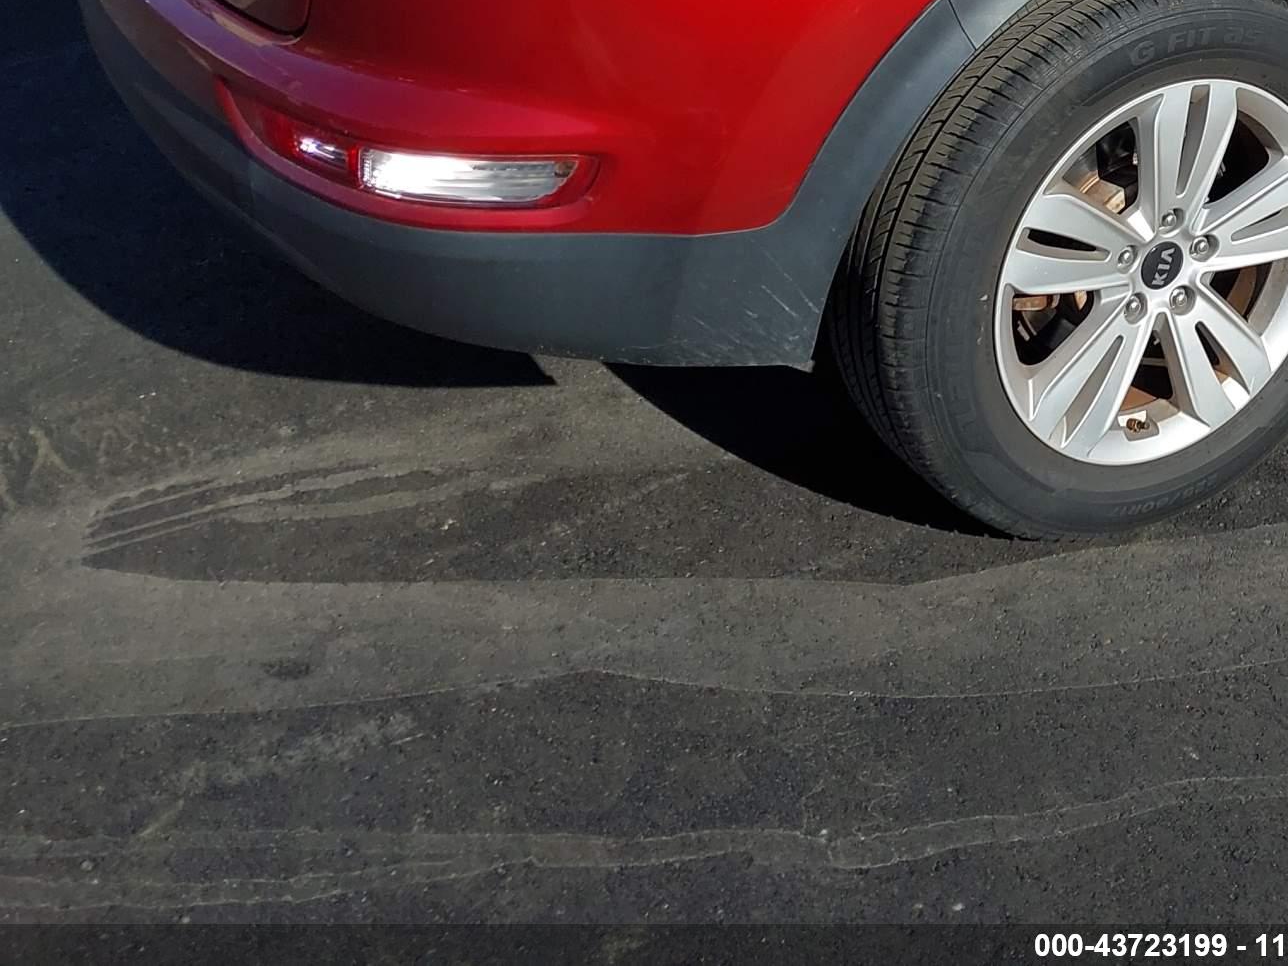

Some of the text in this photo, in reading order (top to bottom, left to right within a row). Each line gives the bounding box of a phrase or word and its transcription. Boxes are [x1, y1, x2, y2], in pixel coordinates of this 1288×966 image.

[1129, 40, 1156, 65] G
[1168, 27, 1216, 52] FIT
[1152, 247, 1176, 285] KIA
